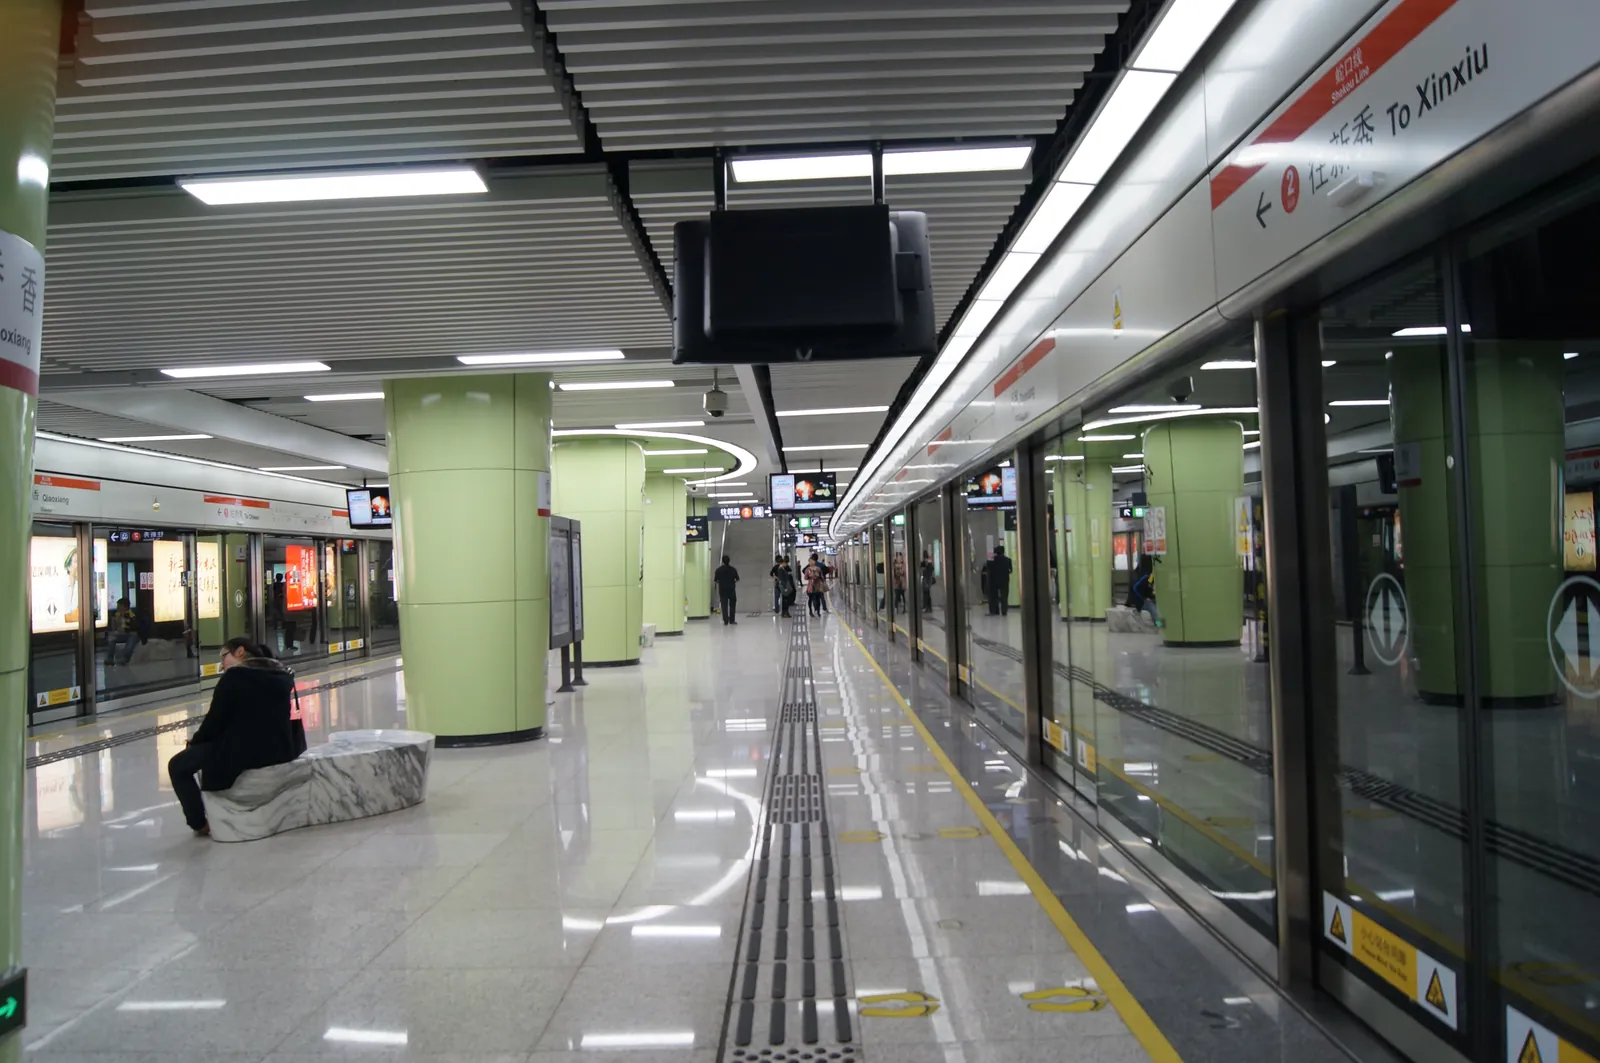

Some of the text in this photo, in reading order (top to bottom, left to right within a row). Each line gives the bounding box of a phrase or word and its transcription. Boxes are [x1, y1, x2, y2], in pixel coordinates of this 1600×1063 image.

[1286, 168, 1296, 195] 2
[1386, 101, 1411, 137] To
[1416, 42, 1489, 119] Xinxiu
[42, 494, 70, 506] Qiaoxiang
